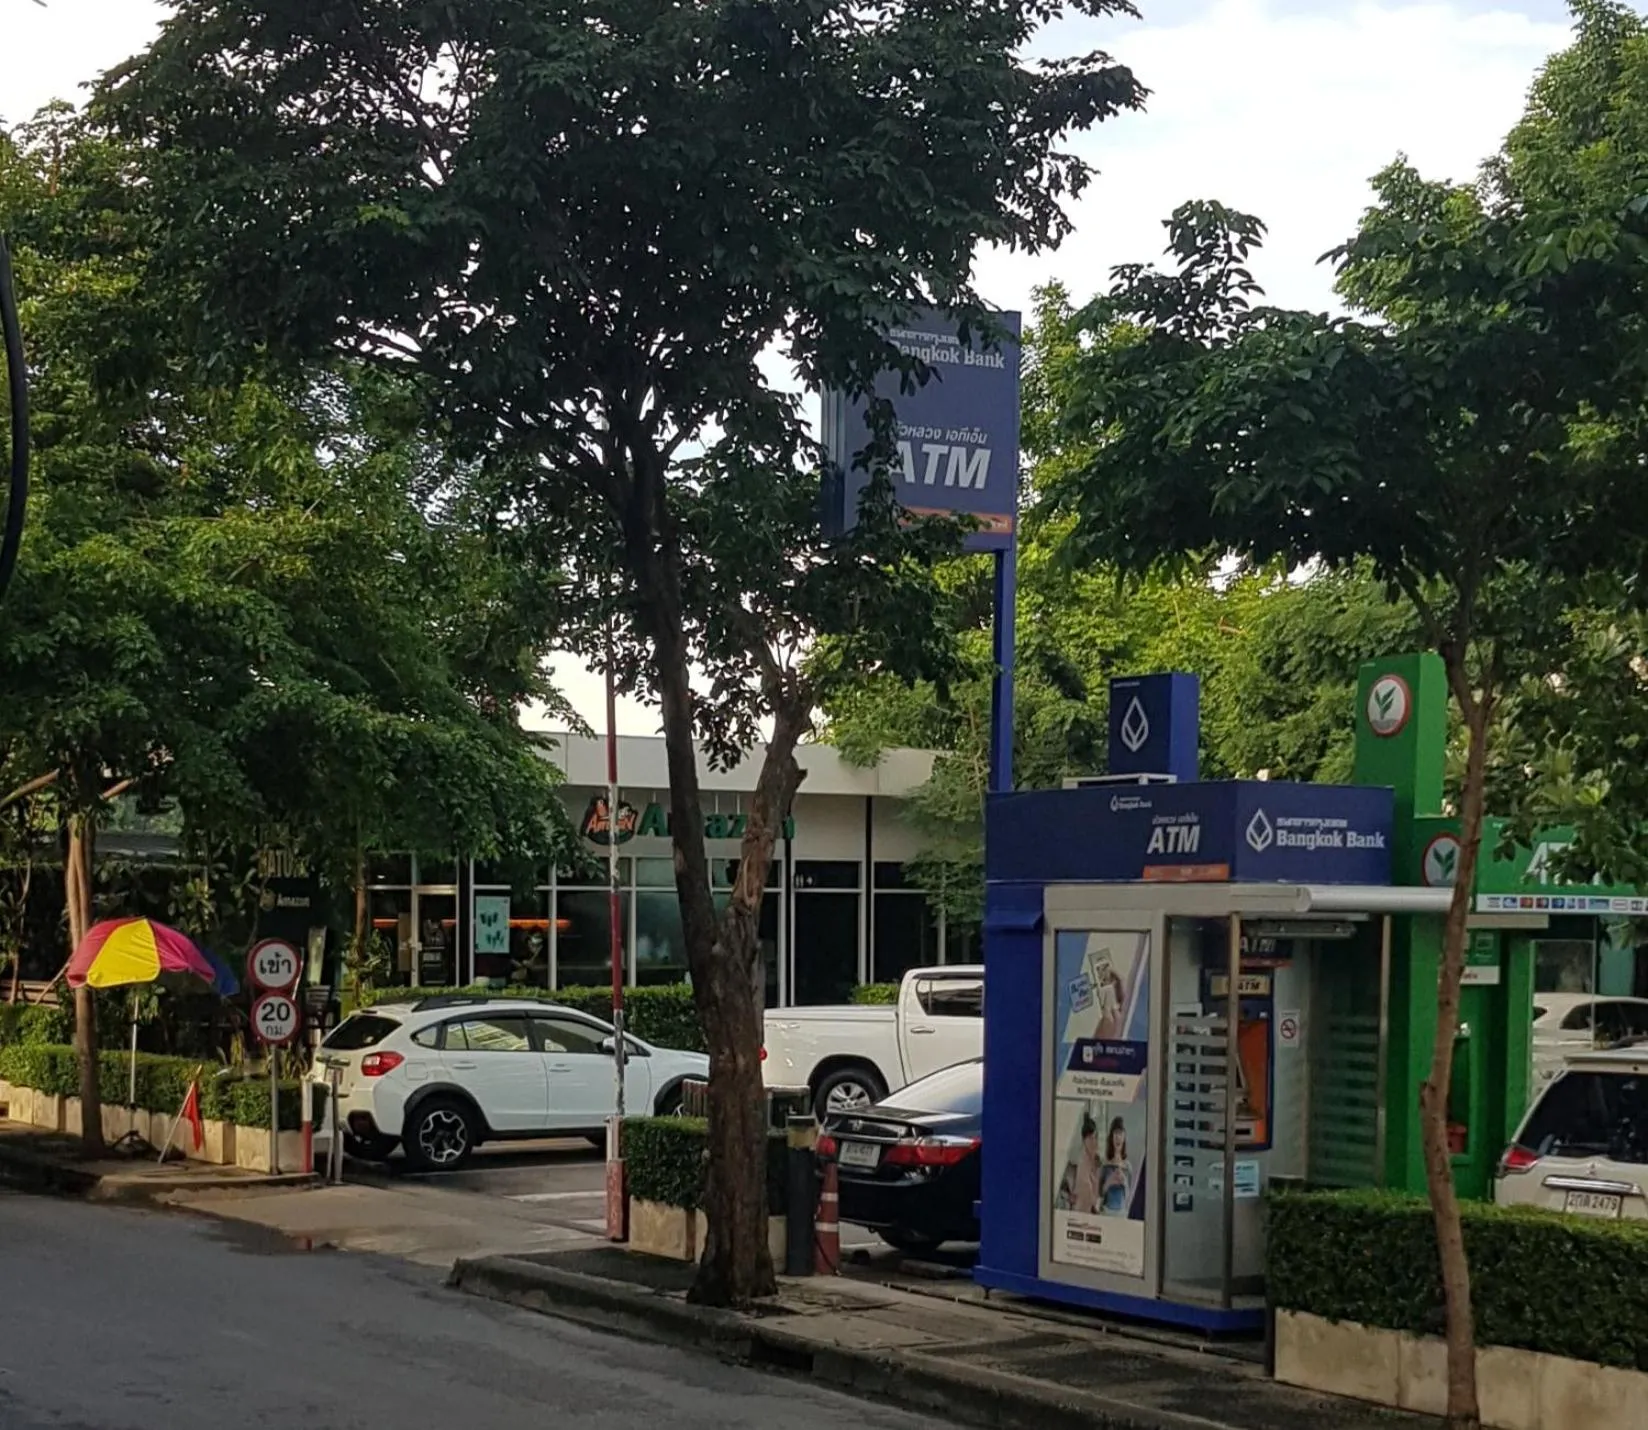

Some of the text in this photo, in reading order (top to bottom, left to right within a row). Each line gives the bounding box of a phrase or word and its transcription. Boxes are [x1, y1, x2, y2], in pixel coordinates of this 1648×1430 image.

[963, 349, 1005, 369] Bank
[890, 440, 991, 489] ATM
[1147, 825, 1199, 853] ATM
[1277, 830, 1384, 849] Bangkok Bank
[259, 952, 292, 975] เข้า
[261, 1003, 291, 1022] 20
[265, 1024, 286, 1037] กม.
